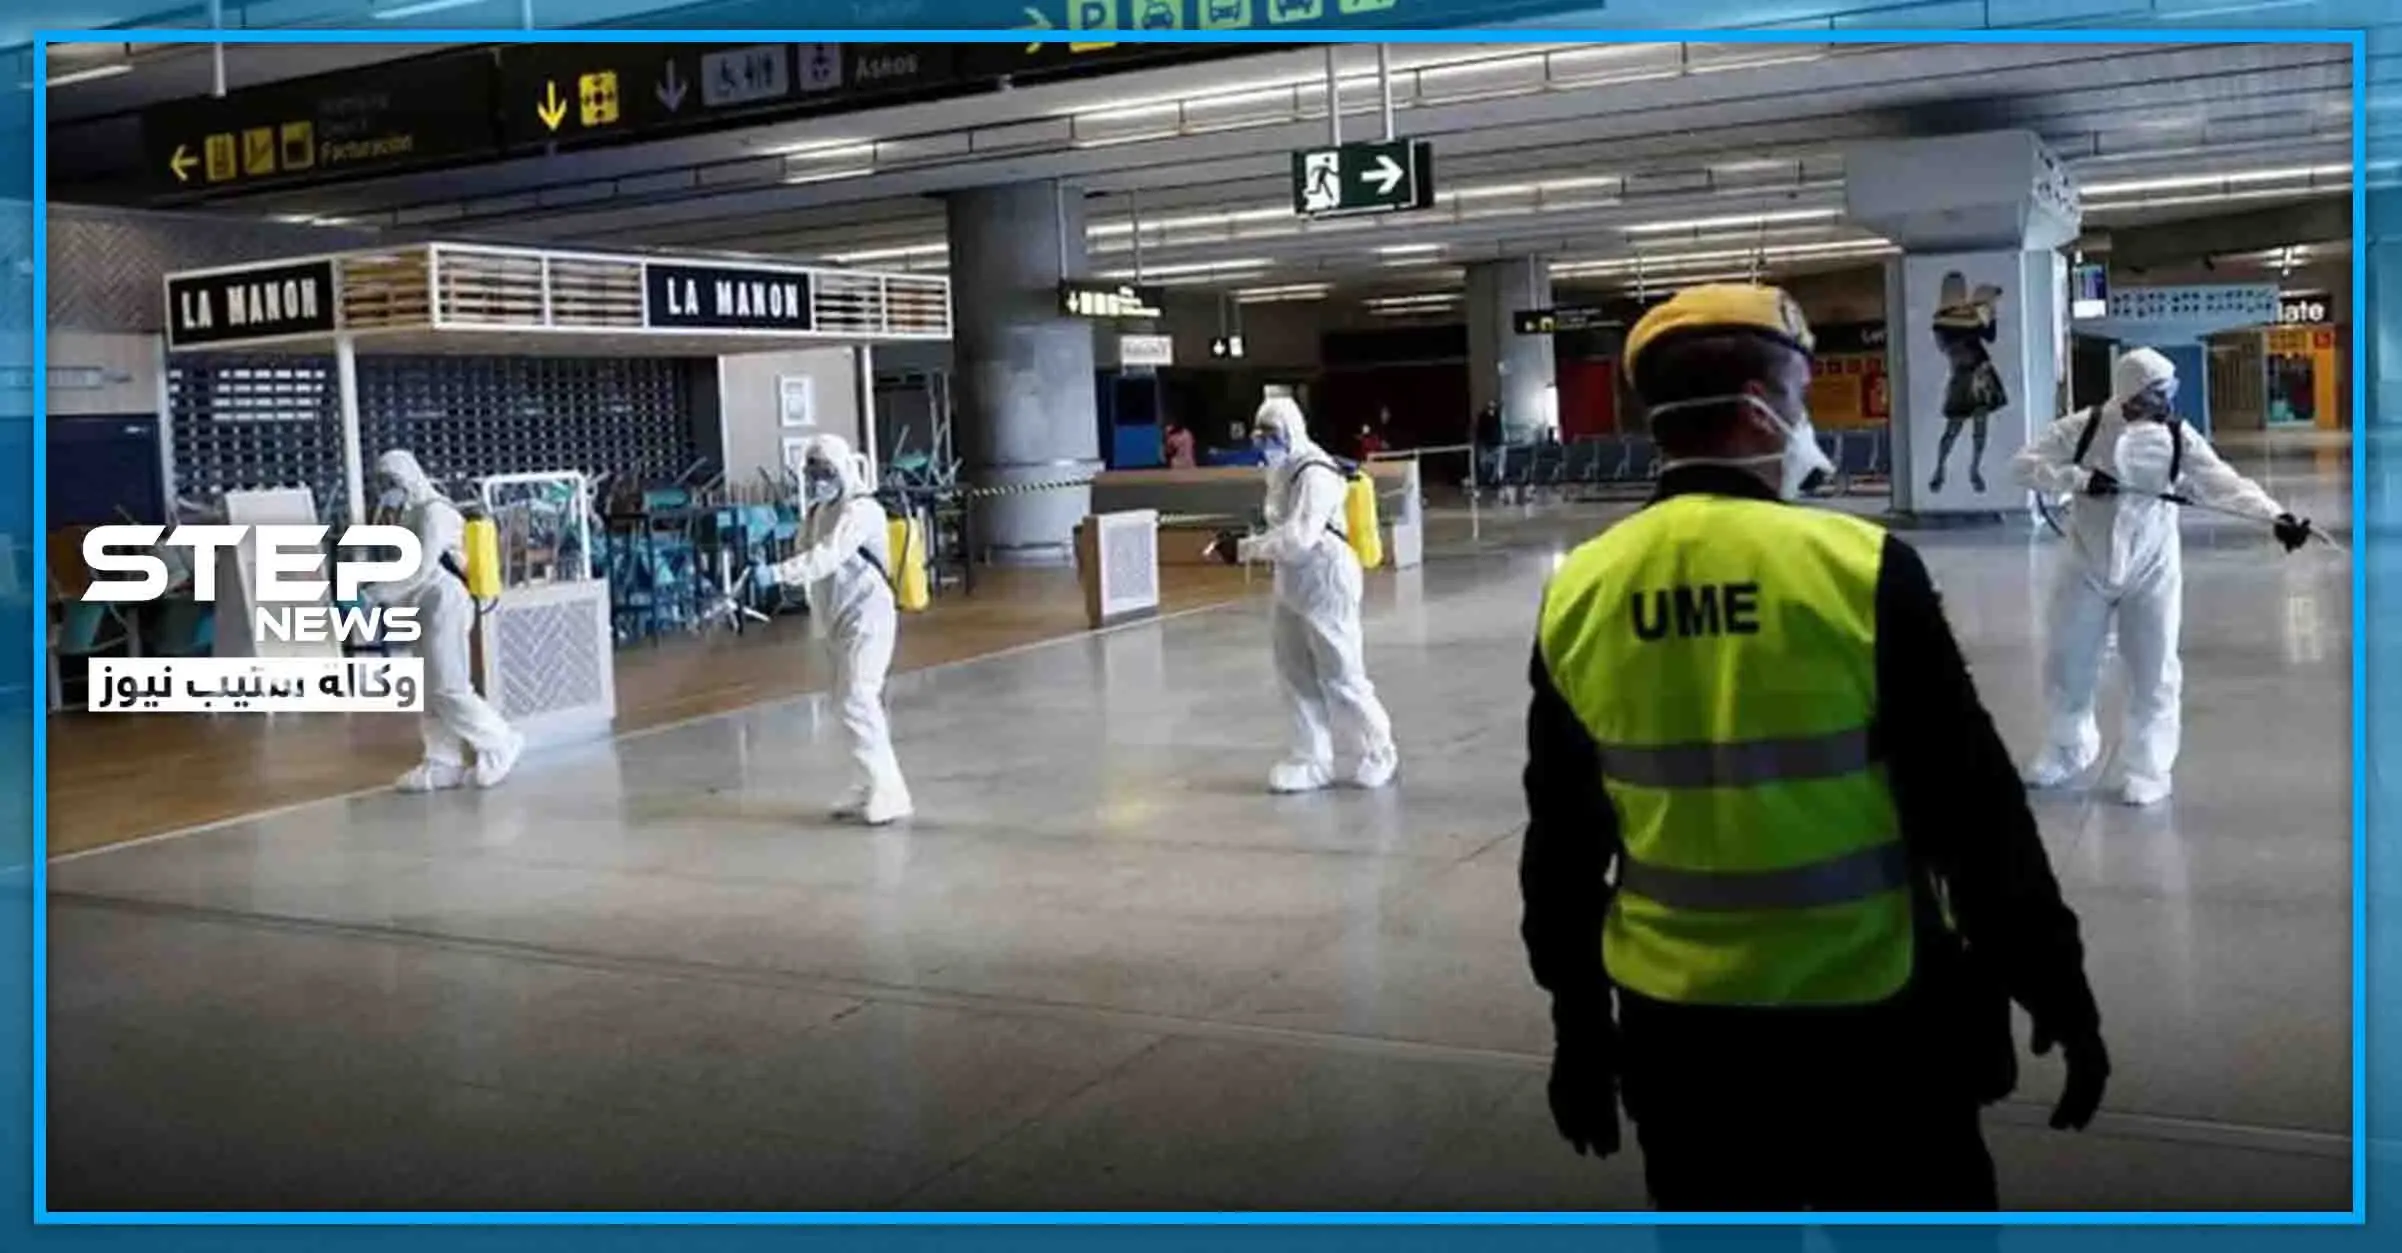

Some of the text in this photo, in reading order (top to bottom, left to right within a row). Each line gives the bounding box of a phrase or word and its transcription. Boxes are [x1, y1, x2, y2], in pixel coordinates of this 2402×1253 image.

[181, 276, 318, 330] LA MANON
[667, 277, 798, 318] LA MANON
[1632, 581, 1760, 643] UME
